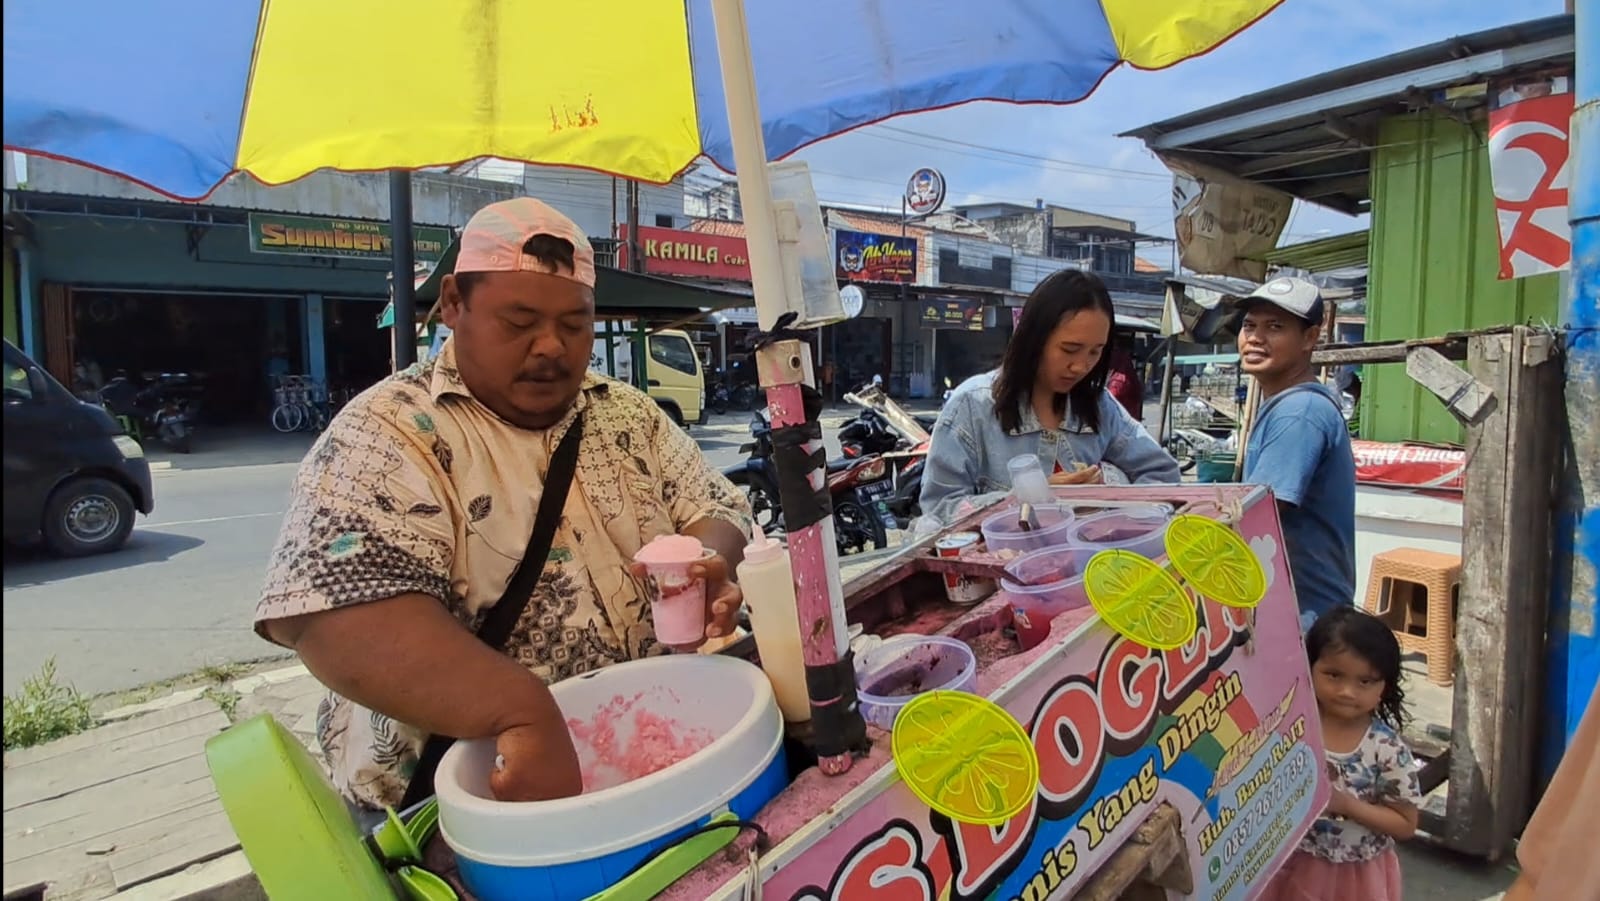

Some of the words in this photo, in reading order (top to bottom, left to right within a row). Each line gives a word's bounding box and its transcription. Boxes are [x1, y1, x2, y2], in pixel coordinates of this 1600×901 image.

[261, 223, 387, 250] Sumber
[644, 239, 719, 263] KAMILA
[1078, 755, 1160, 850] Yang
[1156, 670, 1243, 772] Dingin
[1198, 805, 1237, 856] Hub.
[1235, 763, 1274, 811] Bang
[1270, 714, 1306, 768] RAIT
